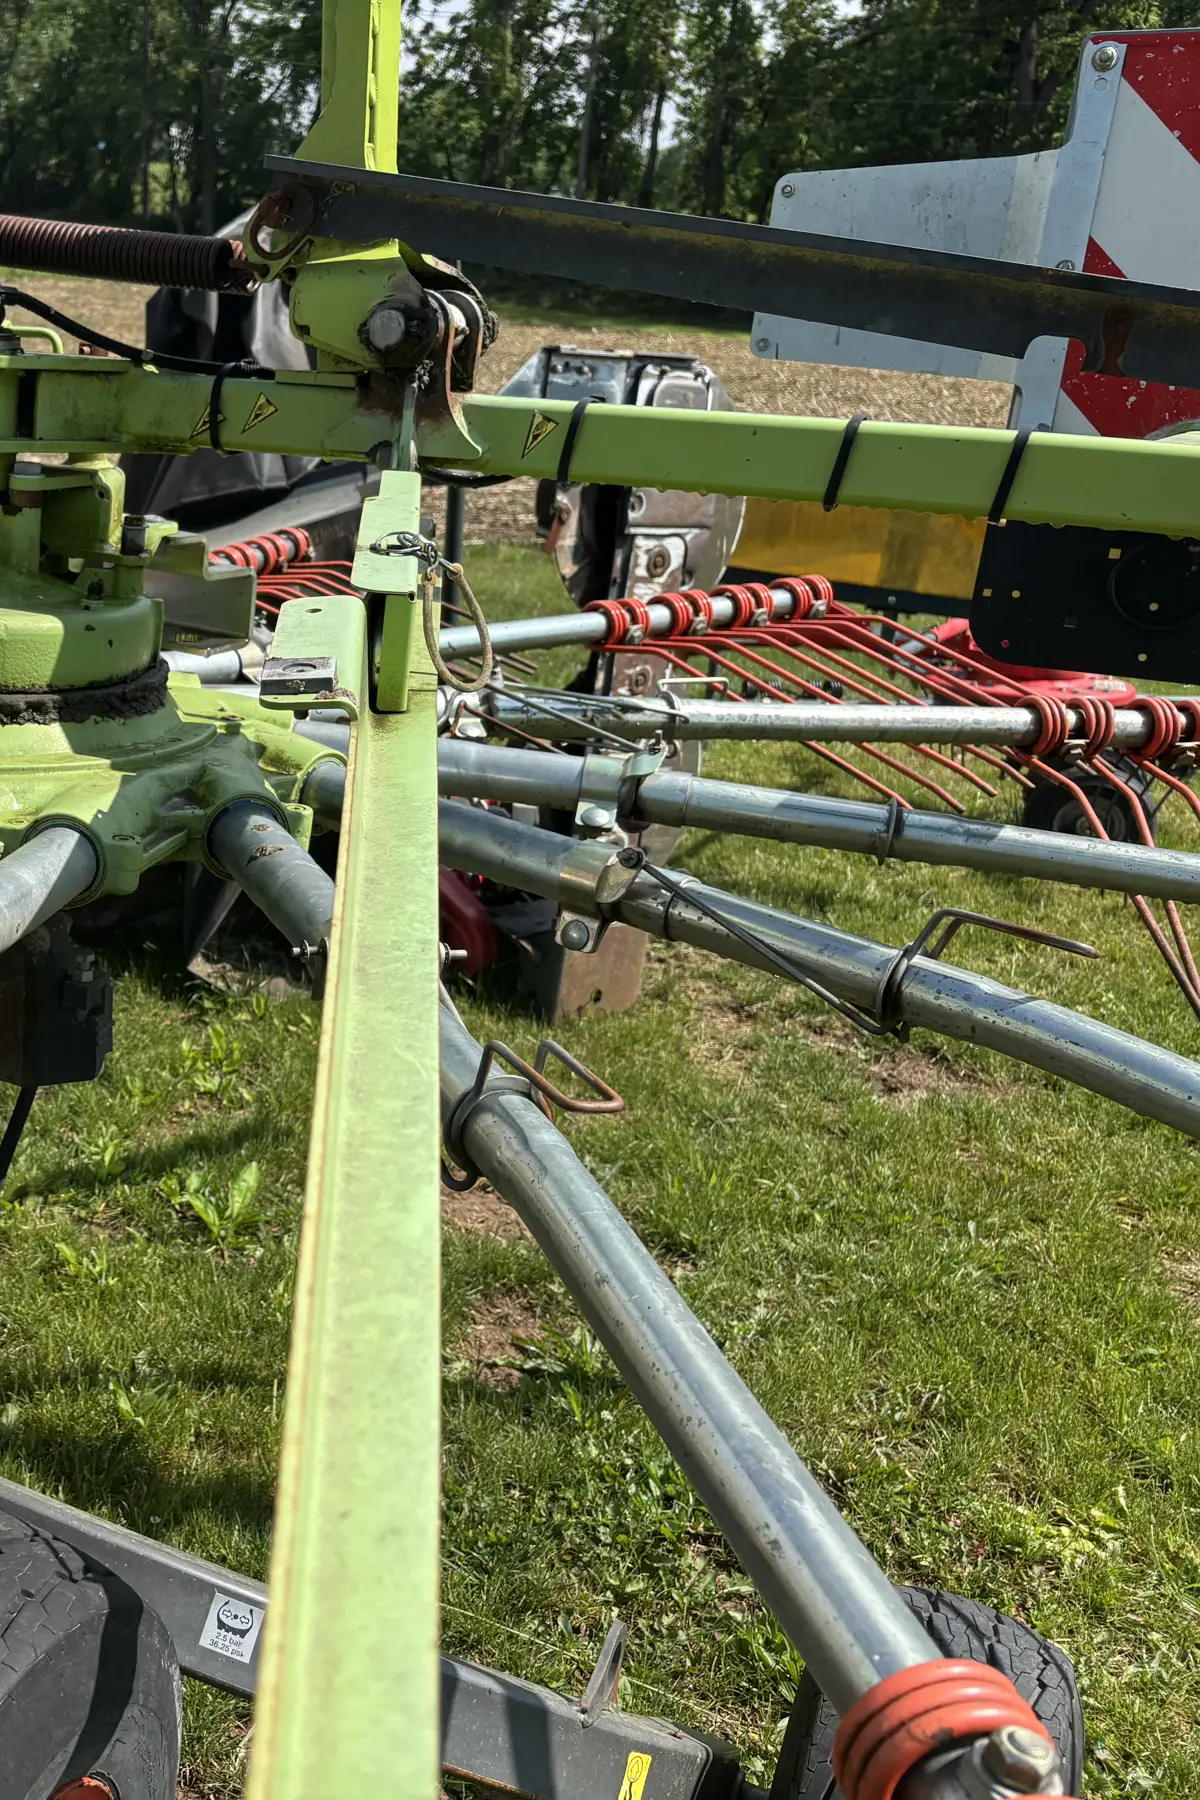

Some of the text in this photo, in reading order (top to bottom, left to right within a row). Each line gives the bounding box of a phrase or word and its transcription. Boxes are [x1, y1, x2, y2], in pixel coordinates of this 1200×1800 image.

[215, 1631, 228, 1642] 2.5
[208, 1638, 244, 1658] 36.25 psi
